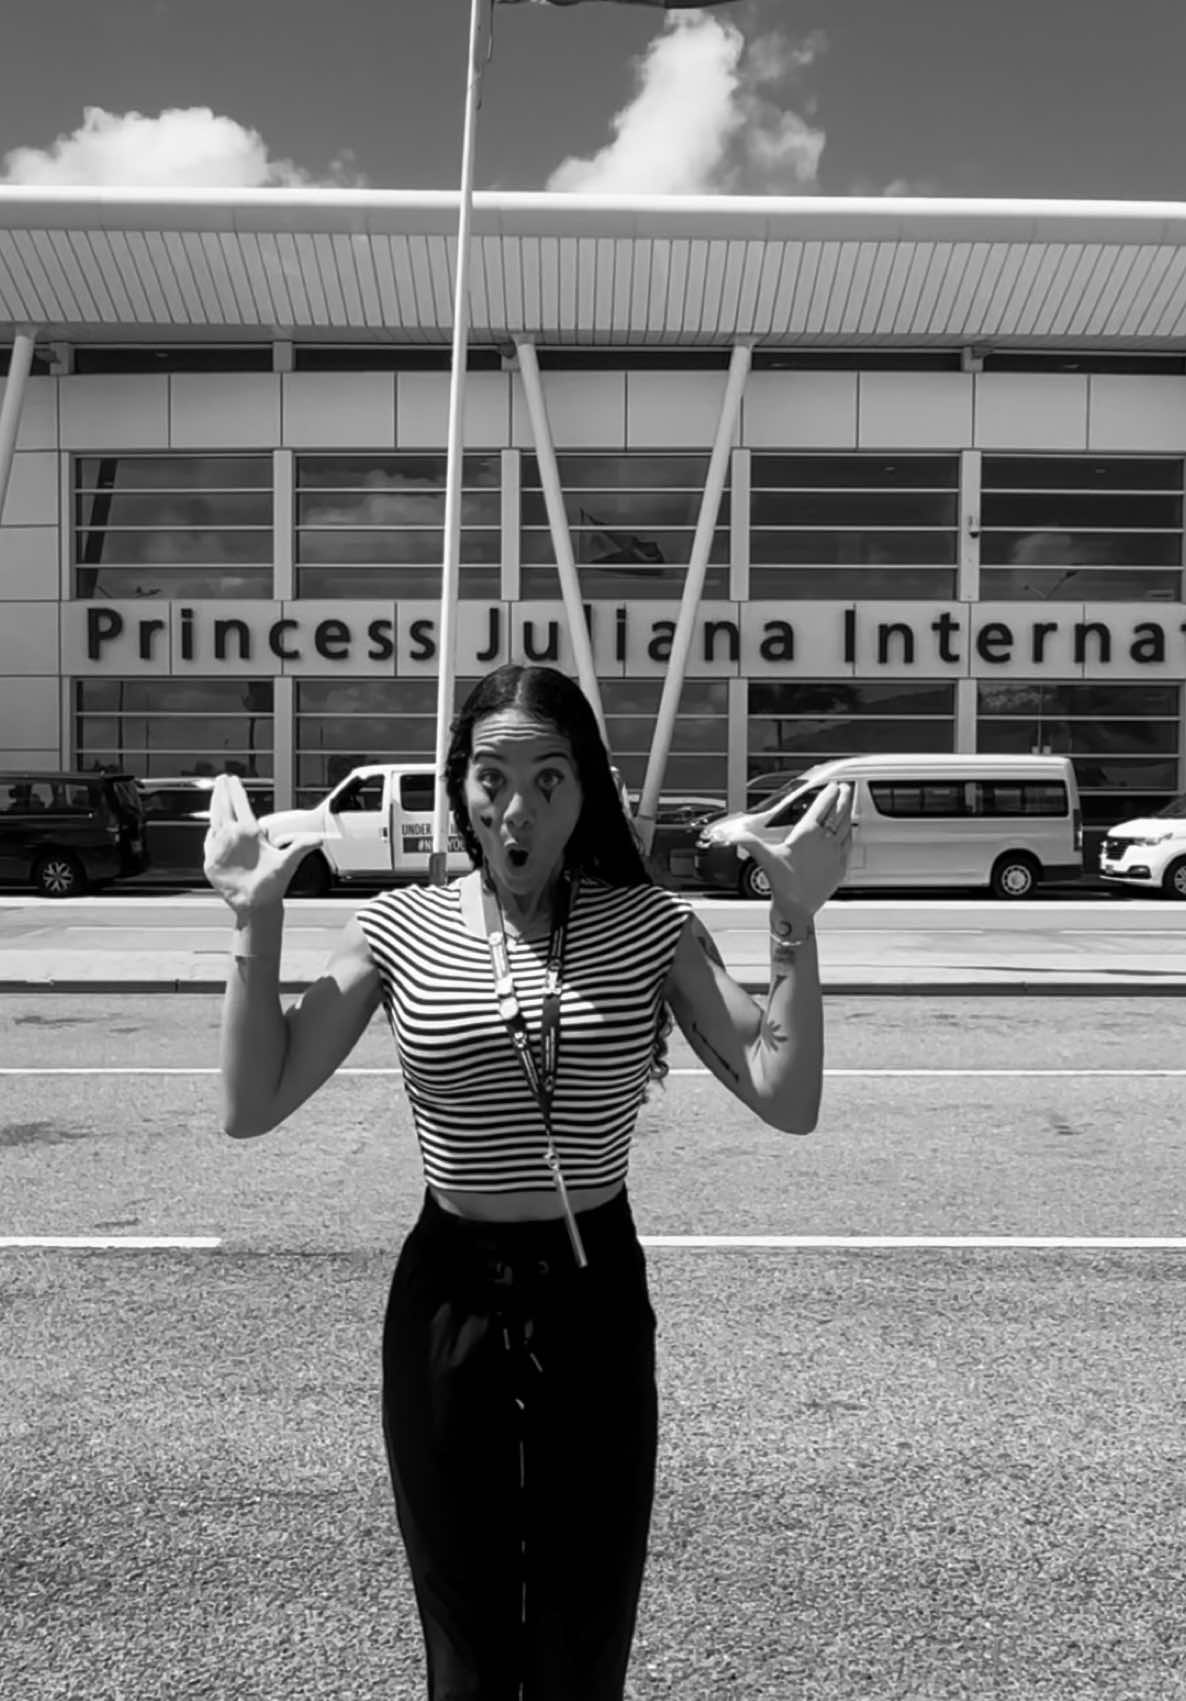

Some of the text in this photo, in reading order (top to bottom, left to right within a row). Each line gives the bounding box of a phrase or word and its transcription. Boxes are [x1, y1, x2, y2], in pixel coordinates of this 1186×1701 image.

[87, 604, 1186, 664] Princess Juiana Interna
